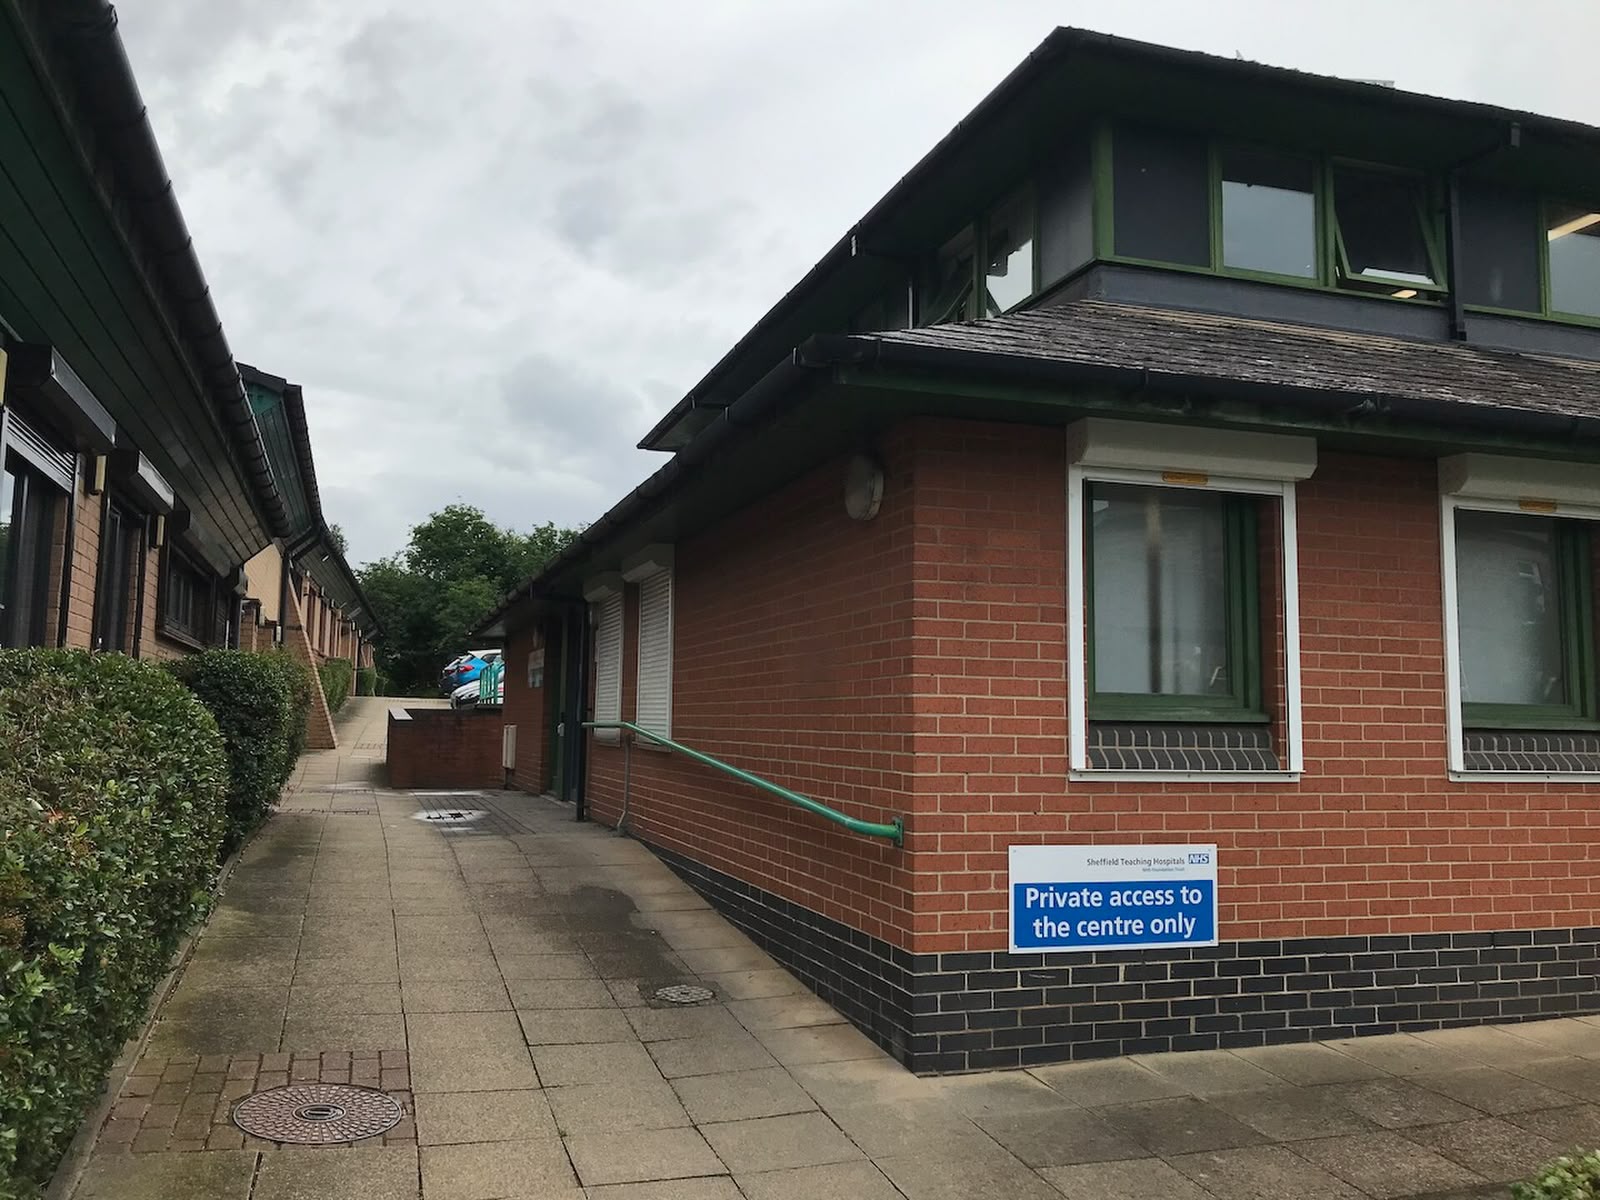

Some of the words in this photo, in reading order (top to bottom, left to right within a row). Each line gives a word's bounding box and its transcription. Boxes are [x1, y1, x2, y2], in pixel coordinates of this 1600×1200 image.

[1087, 858, 1119, 866] Sheffield
[1120, 858, 1152, 867] Teaching
[1153, 857, 1185, 866] Hospitals
[1189, 854, 1209, 864] NHS
[1025, 886, 1103, 908] Private
[1109, 888, 1174, 907] access
[1180, 886, 1202, 905] to
[1033, 916, 1070, 938] the
[1077, 916, 1144, 937] centre
[1150, 912, 1196, 939] only
